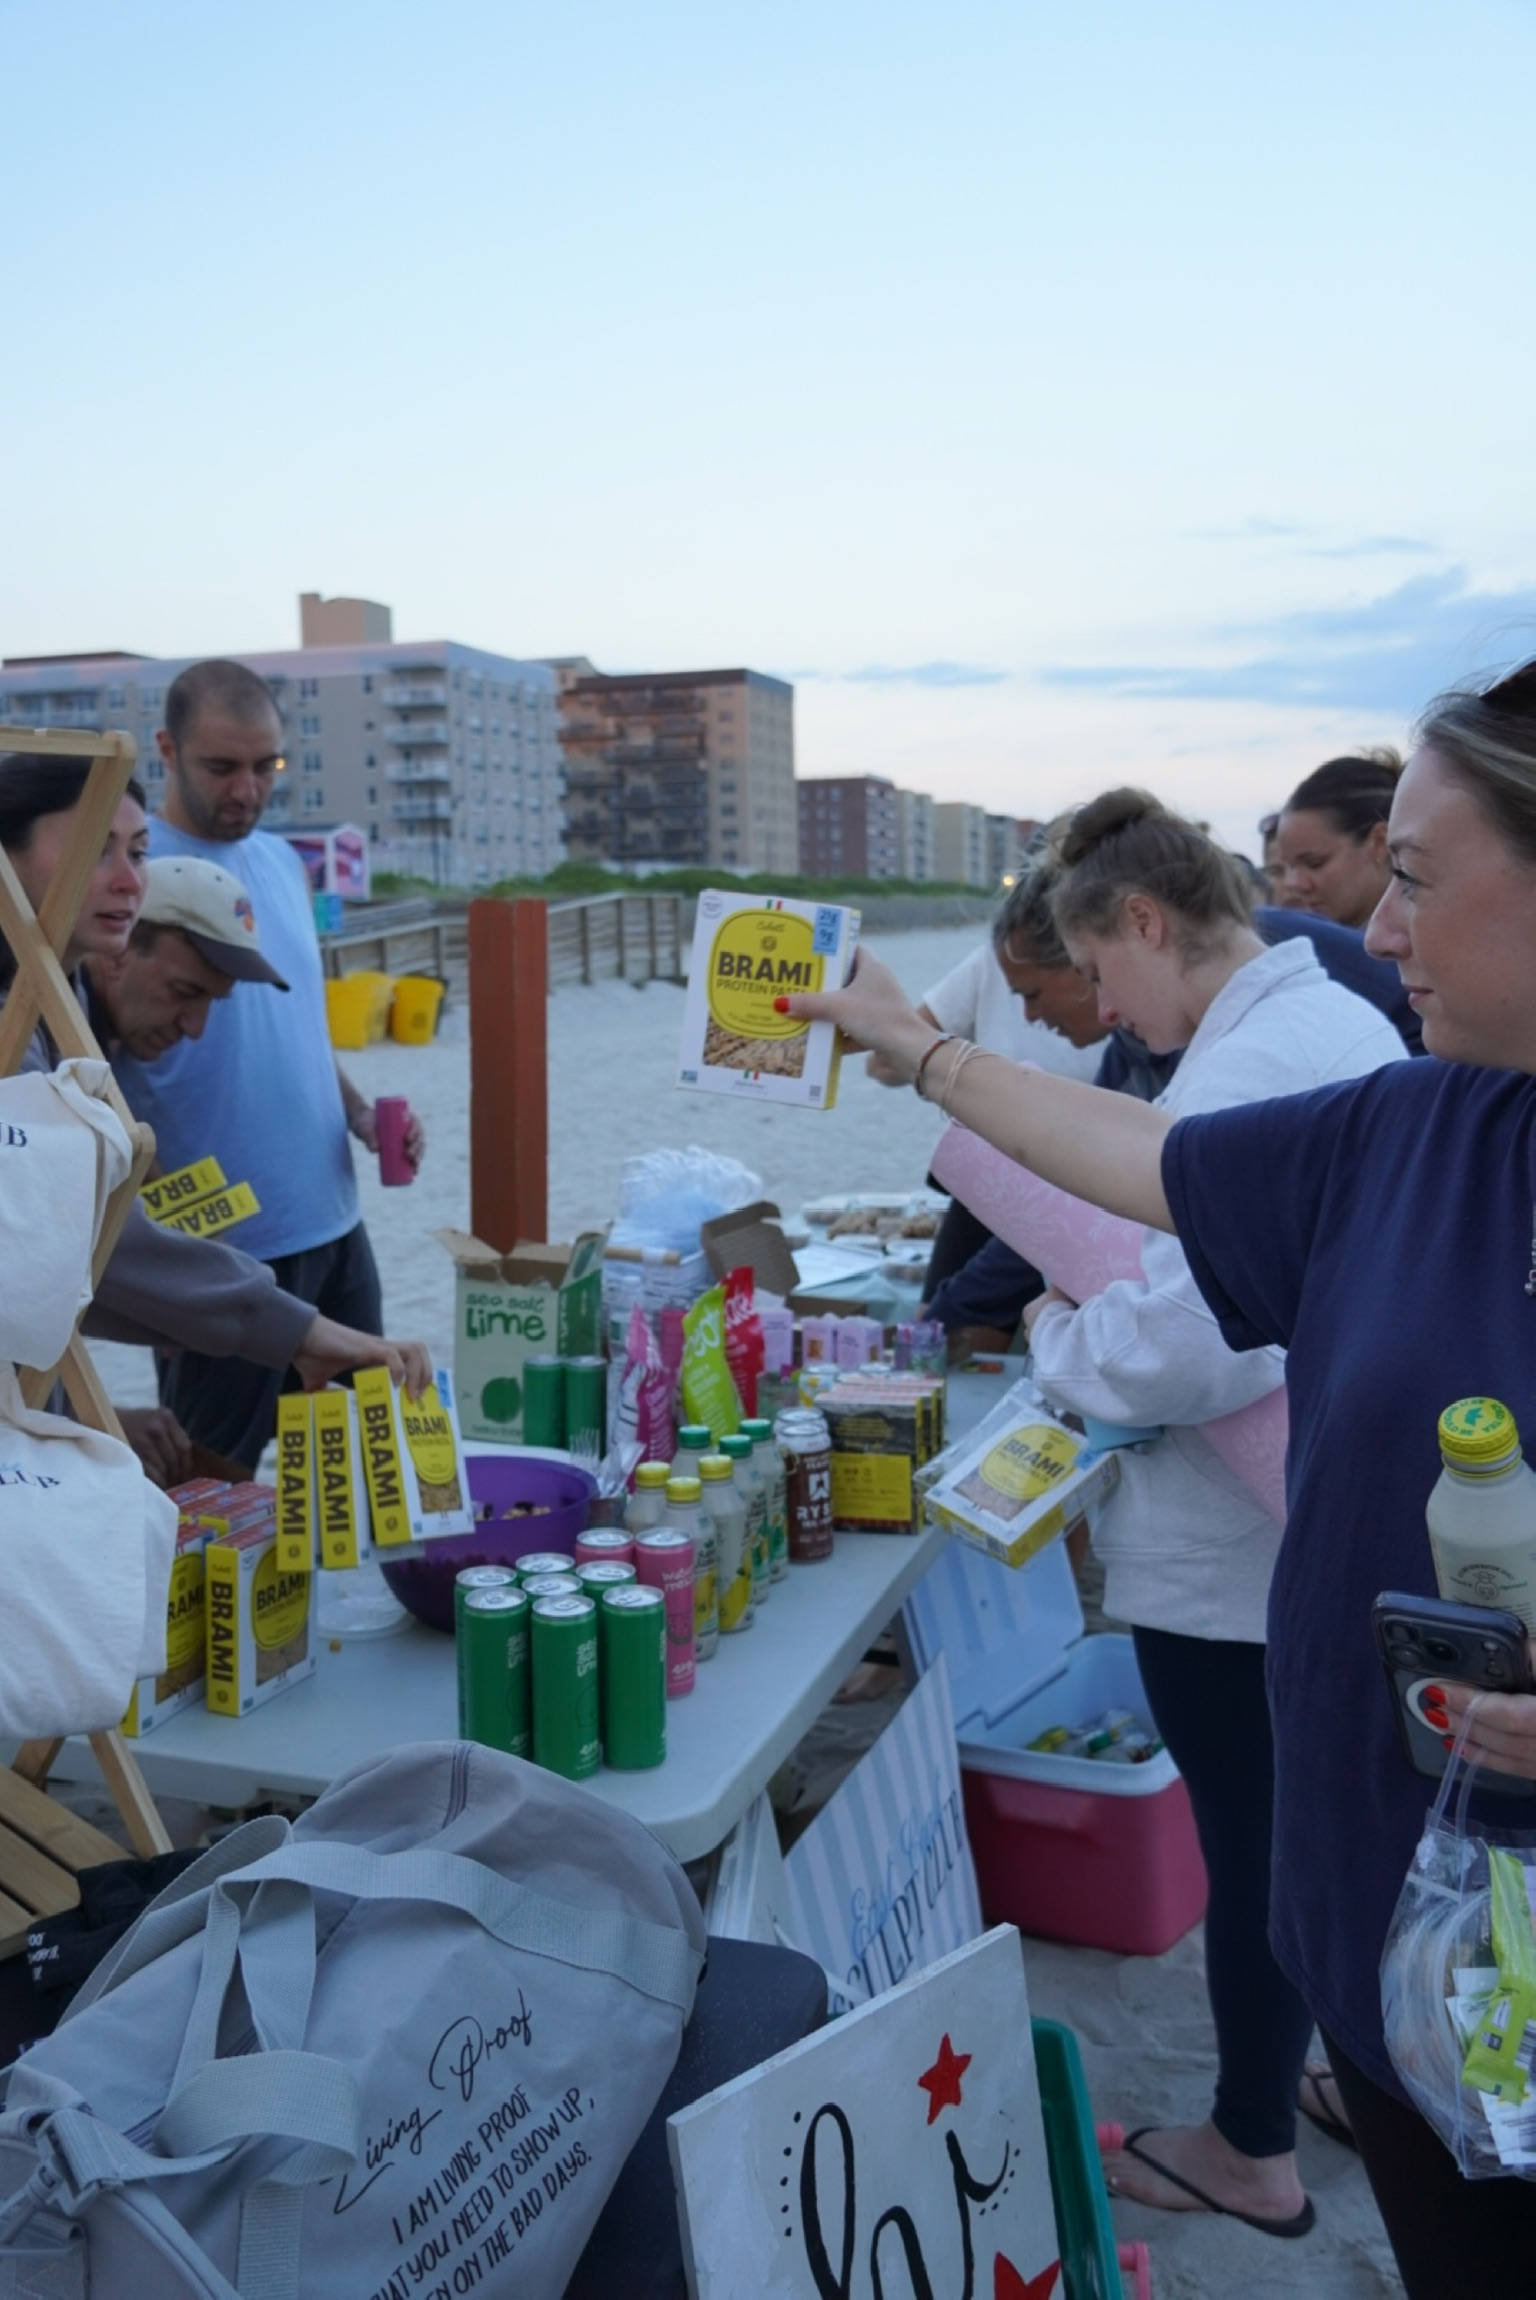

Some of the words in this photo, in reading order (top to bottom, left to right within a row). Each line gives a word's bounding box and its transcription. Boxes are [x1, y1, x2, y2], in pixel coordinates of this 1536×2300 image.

[717, 978, 768, 996] PROTEIN
[770, 985, 806, 997] PAS
[718, 951, 813, 987] BRAMI
[364, 1403, 401, 1508] BRAMI
[405, 1416, 447, 1435] BRAMI
[1003, 1438, 1066, 1479] BRAMI
[283, 1431, 306, 1535] BRAMI
[321, 1427, 350, 1533] BRAMI
[211, 1580, 233, 1683] BRAMI
[257, 1573, 305, 1611] BRAMI
[320, 2107, 443, 2215] Living
[429, 1988, 532, 2101] Proof
[392, 2217, 404, 2245] I
[409, 2187, 439, 2235] AM
[433, 2140, 481, 2206] LIVING
[477, 2083, 532, 2153] PROOF
[406, 2230, 450, 2283] YOU
[452, 2185, 494, 2246] NEED
[487, 2162, 514, 2198] TO
[510, 2112, 561, 2175] SHOW
[556, 2087, 594, 2124] UP,
[453, 2252, 483, 2295] ON
[480, 2219, 515, 2270] THE
[509, 2187, 543, 2239] BAD
[542, 2141, 593, 2202] DAYS.
